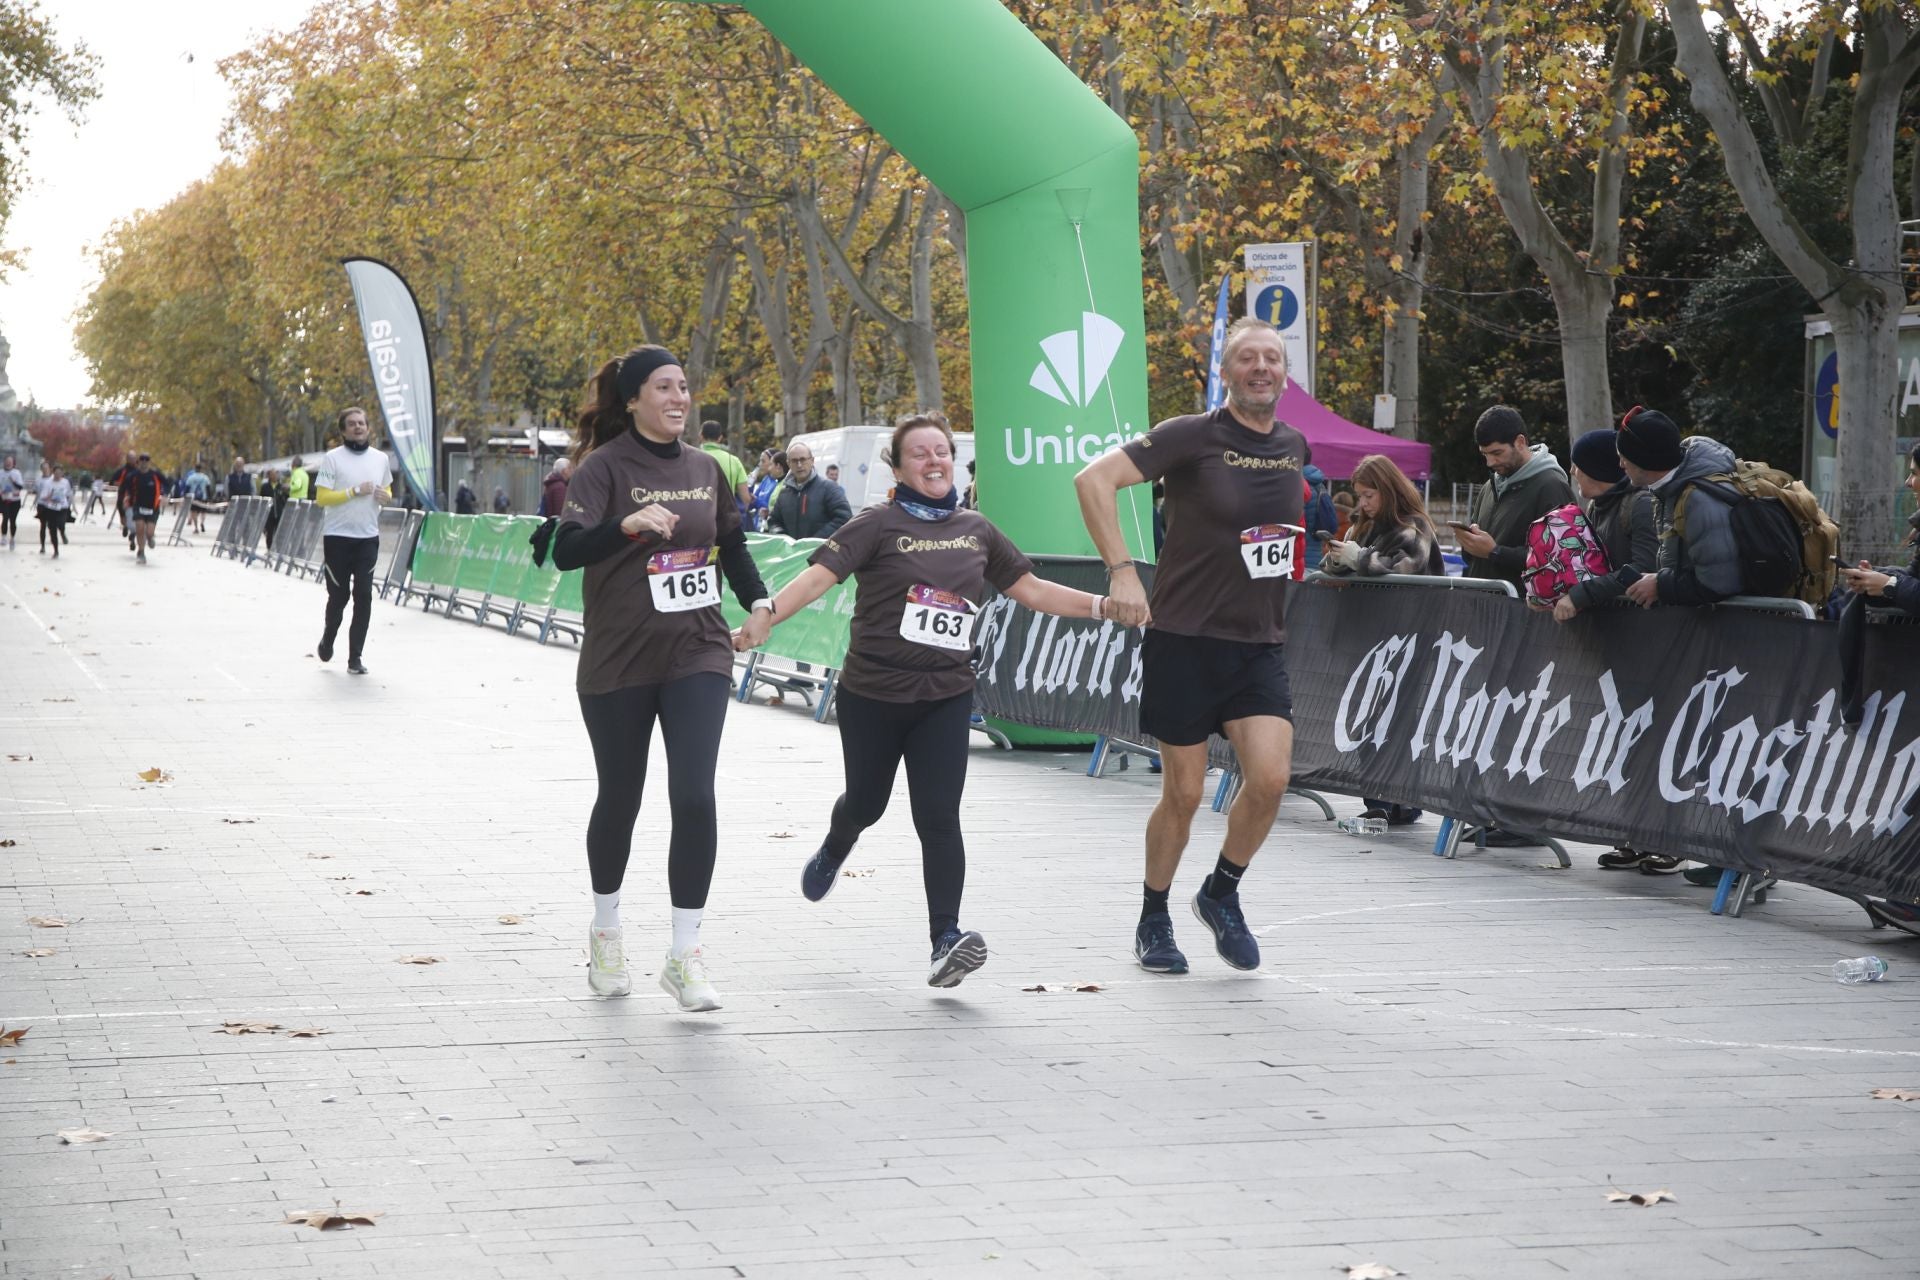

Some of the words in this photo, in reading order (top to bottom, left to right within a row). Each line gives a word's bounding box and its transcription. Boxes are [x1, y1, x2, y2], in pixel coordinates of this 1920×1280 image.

[1252, 252, 1277, 261] Oficina
[1278, 252, 1288, 260] de
[1261, 273, 1285, 282] rística
[1005, 422, 1145, 466] Unica
[1252, 540, 1289, 566] 164
[662, 570, 708, 599] 165
[915, 608, 963, 637] 163
[1334, 632, 1417, 752] El
[1410, 630, 1571, 785] Norte
[1571, 668, 1654, 796] de
